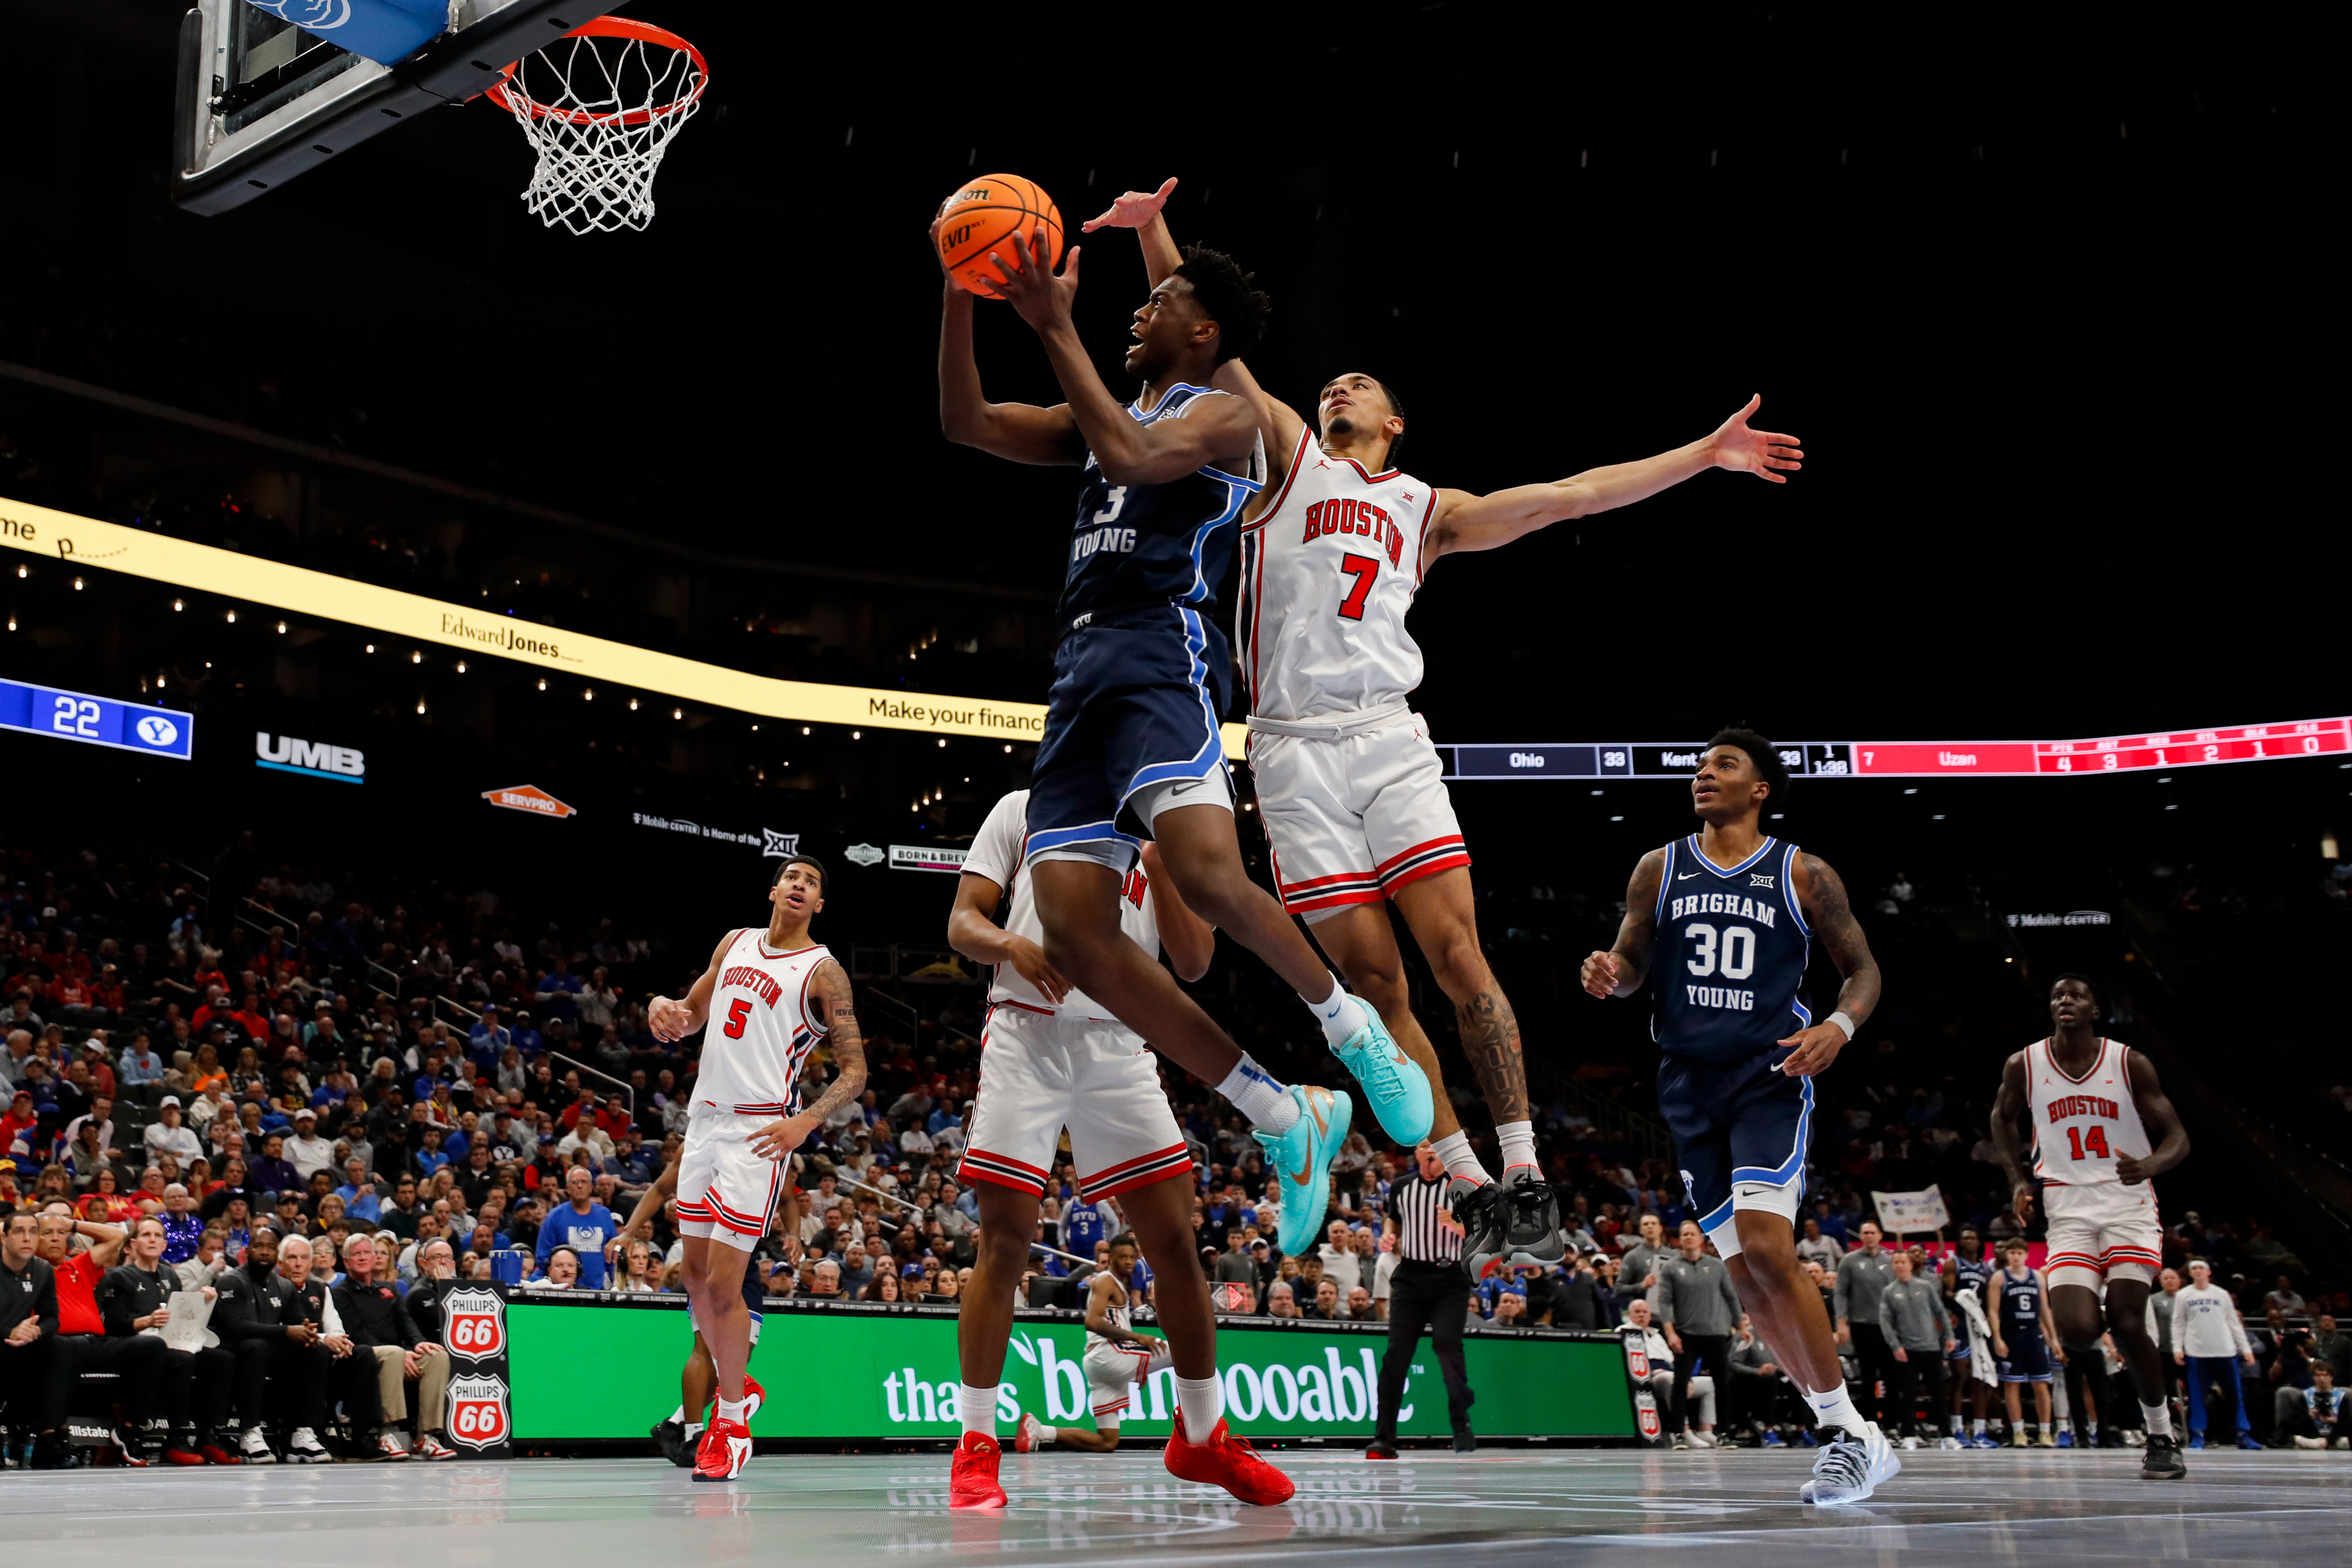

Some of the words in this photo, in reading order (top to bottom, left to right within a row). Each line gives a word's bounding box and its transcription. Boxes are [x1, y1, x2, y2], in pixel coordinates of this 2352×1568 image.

[1074, 528, 1137, 561] YOUNG
[1302, 499, 1404, 572] HOUSTON
[1337, 552, 1380, 622] 7
[441, 612, 506, 647] Edward
[507, 629, 560, 659] Jones
[53, 695, 100, 738] 22
[869, 697, 925, 720] Make
[929, 708, 975, 726] your
[146, 720, 170, 742] Y
[256, 731, 365, 777] UMB
[1509, 753, 1544, 768] Ohio
[1603, 752, 1625, 768] 33
[1661, 751, 1697, 767] Kent
[1824, 744, 1835, 758] 1
[1863, 752, 1874, 766] 7
[1939, 751, 1976, 767] Uzan
[2056, 757, 2072, 772] 4
[2103, 753, 2118, 769] 3
[2154, 749, 2169, 765] 1
[2204, 745, 2219, 761] 2
[2252, 741, 2266, 757] 1
[2303, 737, 2320, 753] 0
[502, 793, 556, 811] SERVPRO
[642, 814, 669, 829] Mobile
[670, 820, 699, 835] CENTER
[702, 826, 710, 837] is
[712, 829, 735, 842] Home
[739, 833, 746, 844] of
[747, 834, 761, 846] the
[898, 851, 927, 860] BORN
[1671, 894, 1776, 928] BRIGHAM
[1686, 924, 1755, 979] 30
[720, 966, 782, 1010] HOUSTON
[1686, 985, 1753, 1011] YOUNG
[723, 997, 753, 1040] 5
[2049, 1095, 2119, 1123] HOUSTON
[2067, 1126, 2110, 1160] 14
[1073, 1211, 1096, 1221] BYU
[1080, 1221, 1090, 1235] 3
[452, 1299, 495, 1312] PHILLIPS
[2019, 1294, 2031, 1311] 6
[456, 1319, 493, 1345] 66
[456, 1386, 499, 1398] PHILLIPS
[459, 1406, 497, 1432] 66
